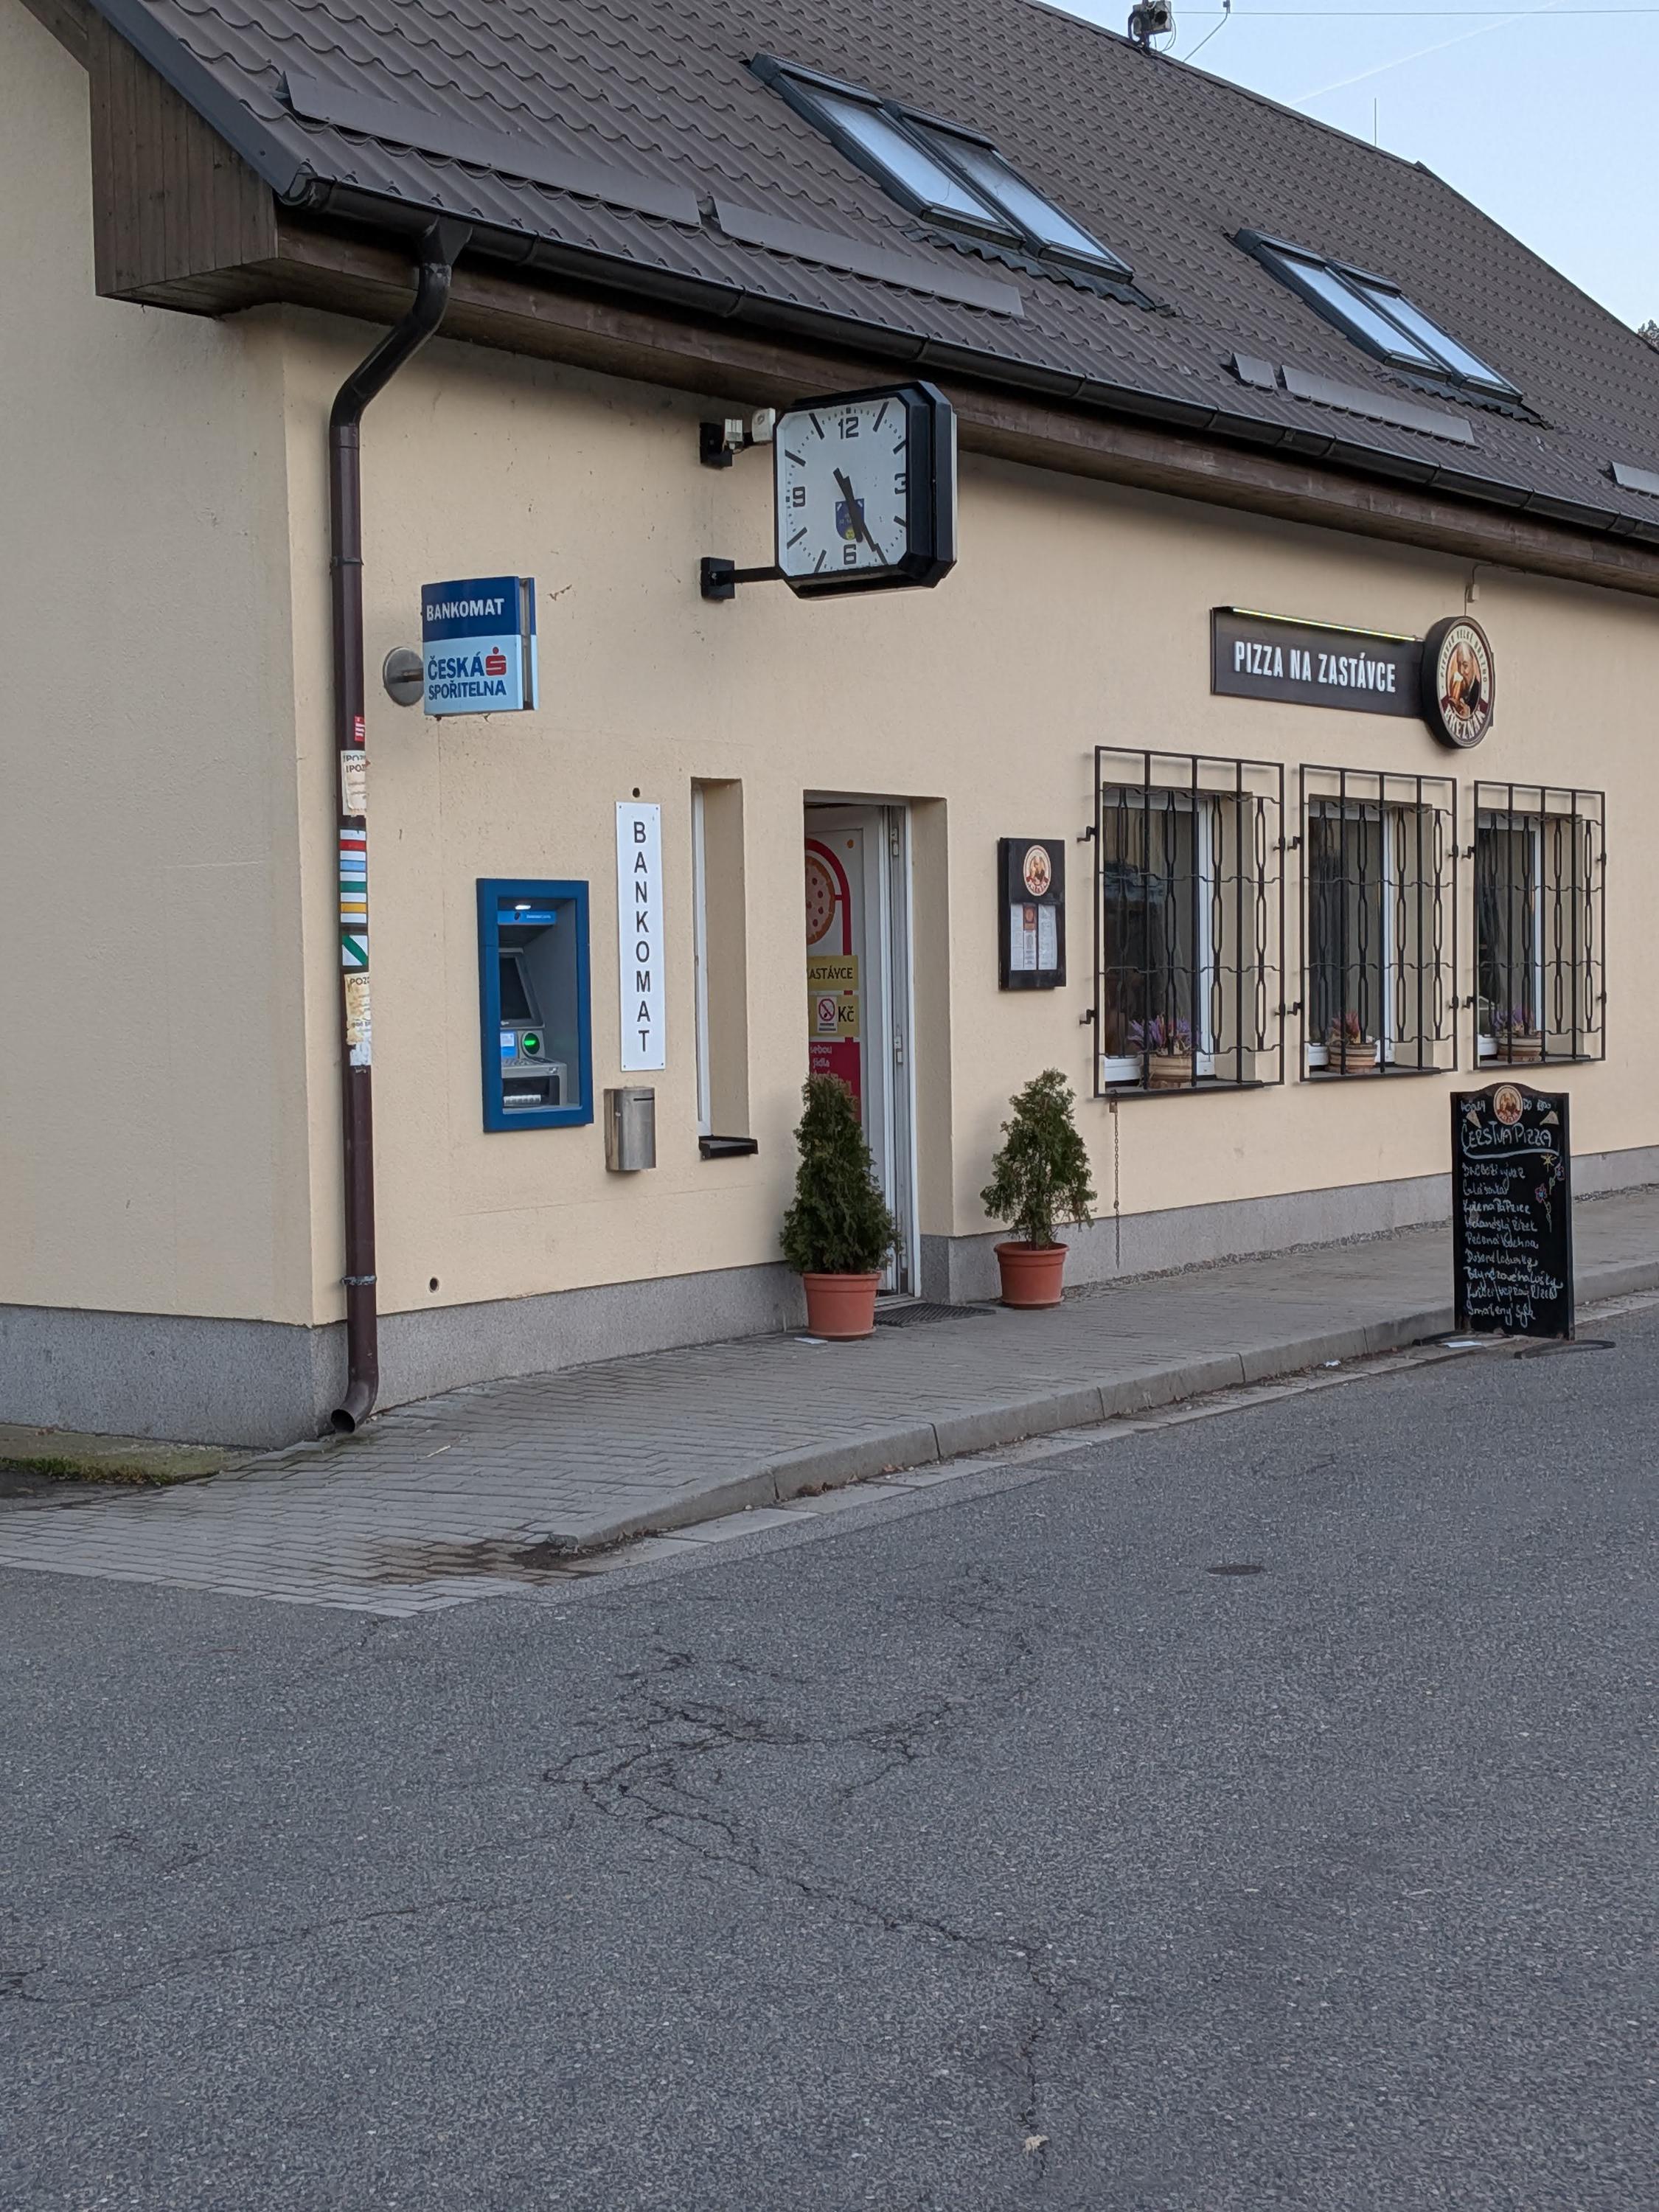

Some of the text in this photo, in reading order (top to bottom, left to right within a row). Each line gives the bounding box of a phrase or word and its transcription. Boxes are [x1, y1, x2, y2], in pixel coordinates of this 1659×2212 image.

[838, 417, 859, 439] 12
[793, 486, 806, 508] 9
[844, 543, 857, 565] 6
[426, 598, 504, 622] BANKOMAT
[428, 652, 484, 681] ČESKÁ
[1234, 641, 1396, 692] PIZZA NA ZASTÁVCE
[428, 680, 507, 700] SPOŘITELNA
[633, 821, 651, 1052] BANKOMAT
[809, 965, 853, 979] ASTÁVCE
[838, 1006, 854, 1023] Kč
